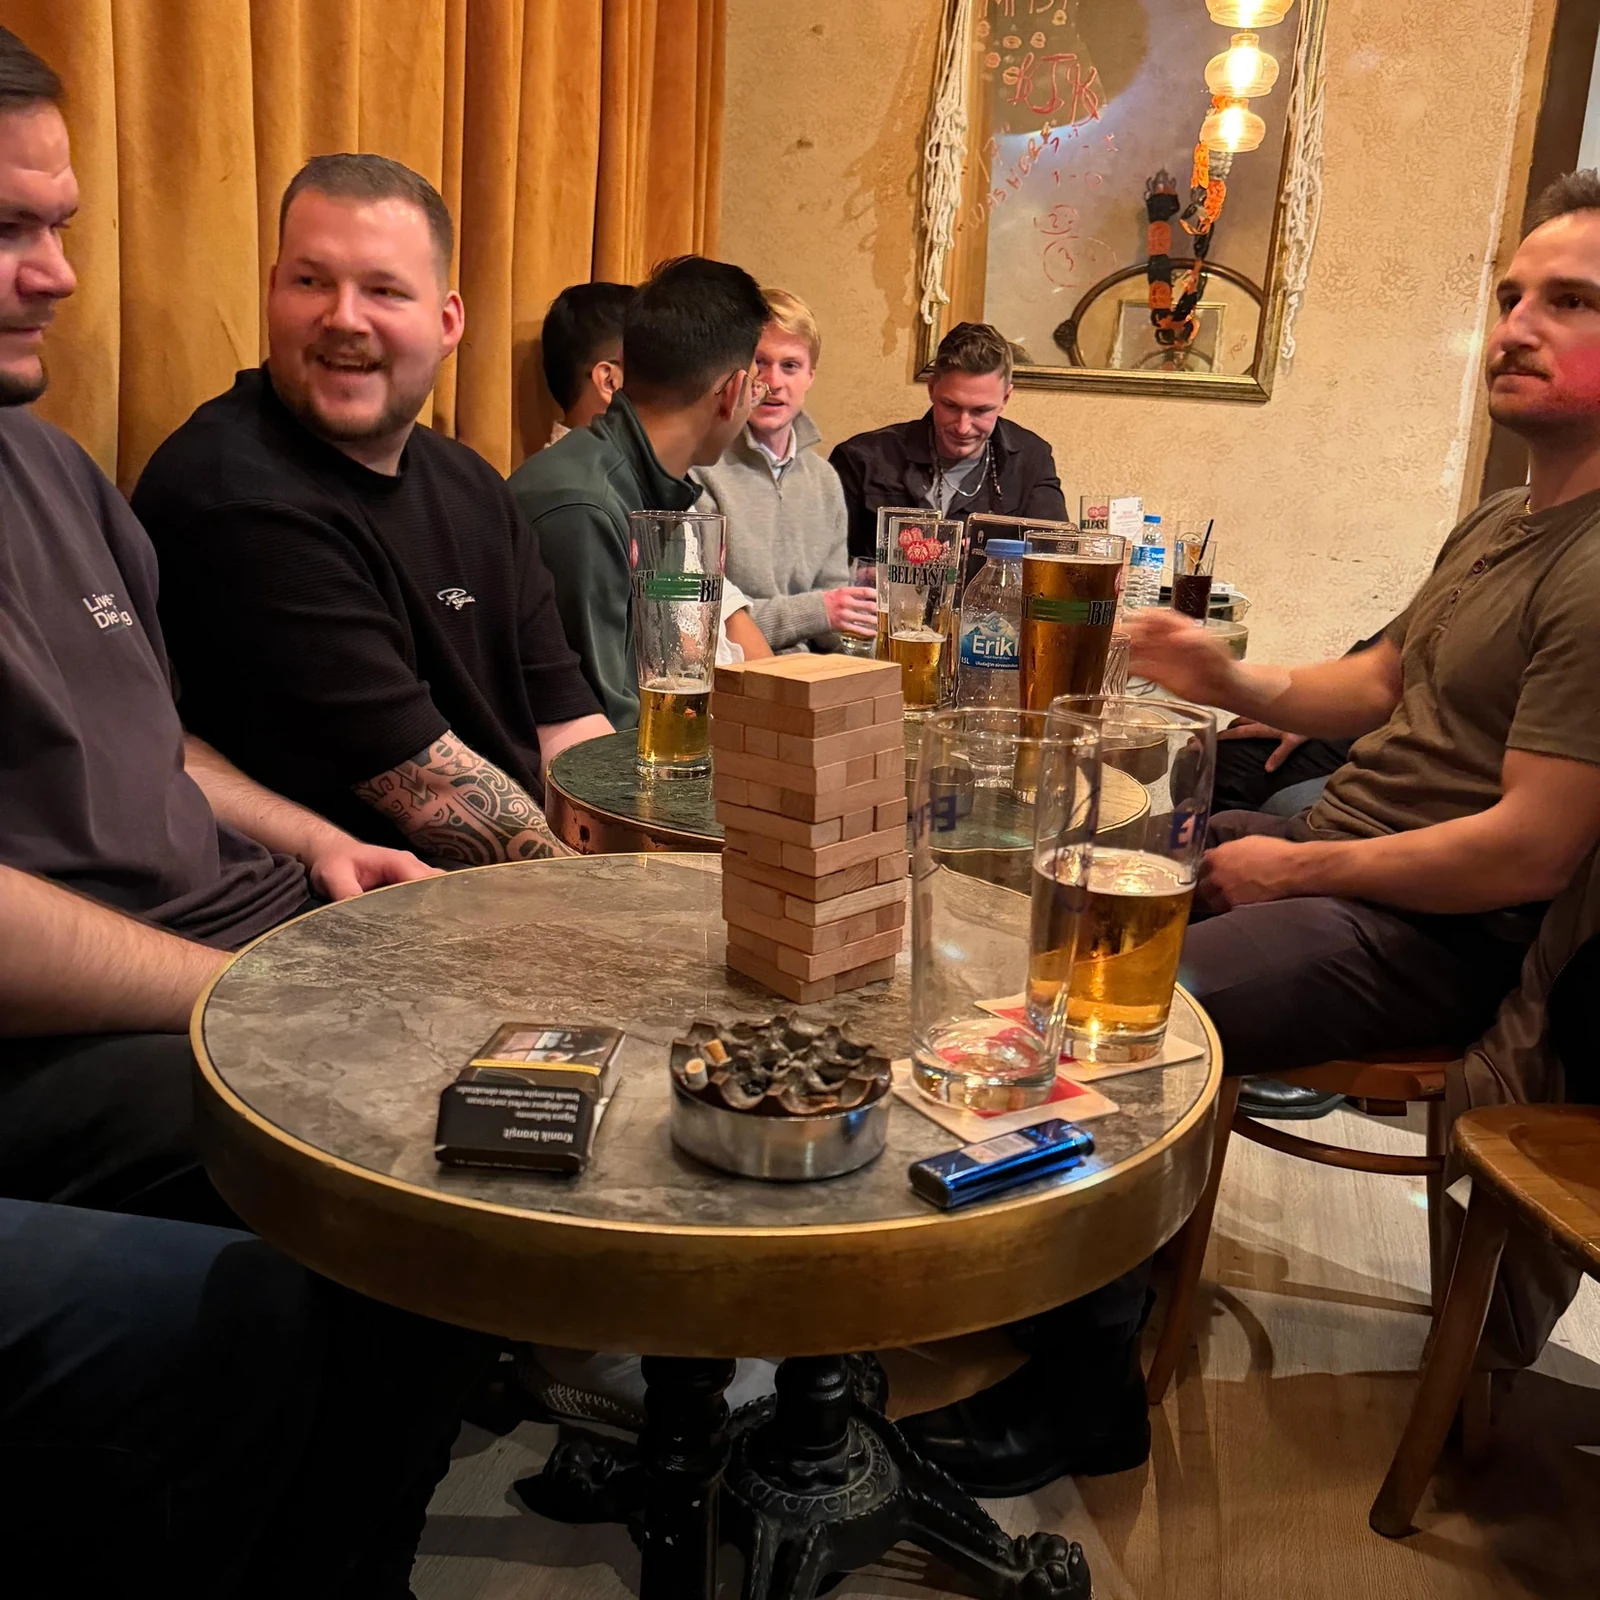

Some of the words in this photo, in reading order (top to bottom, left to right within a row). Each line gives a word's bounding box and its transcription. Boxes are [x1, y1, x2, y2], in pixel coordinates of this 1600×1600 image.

[891, 564, 948, 587] BELFAST
[972, 634, 1020, 656] Erikl
[541, 1131, 574, 1143] Kronik
